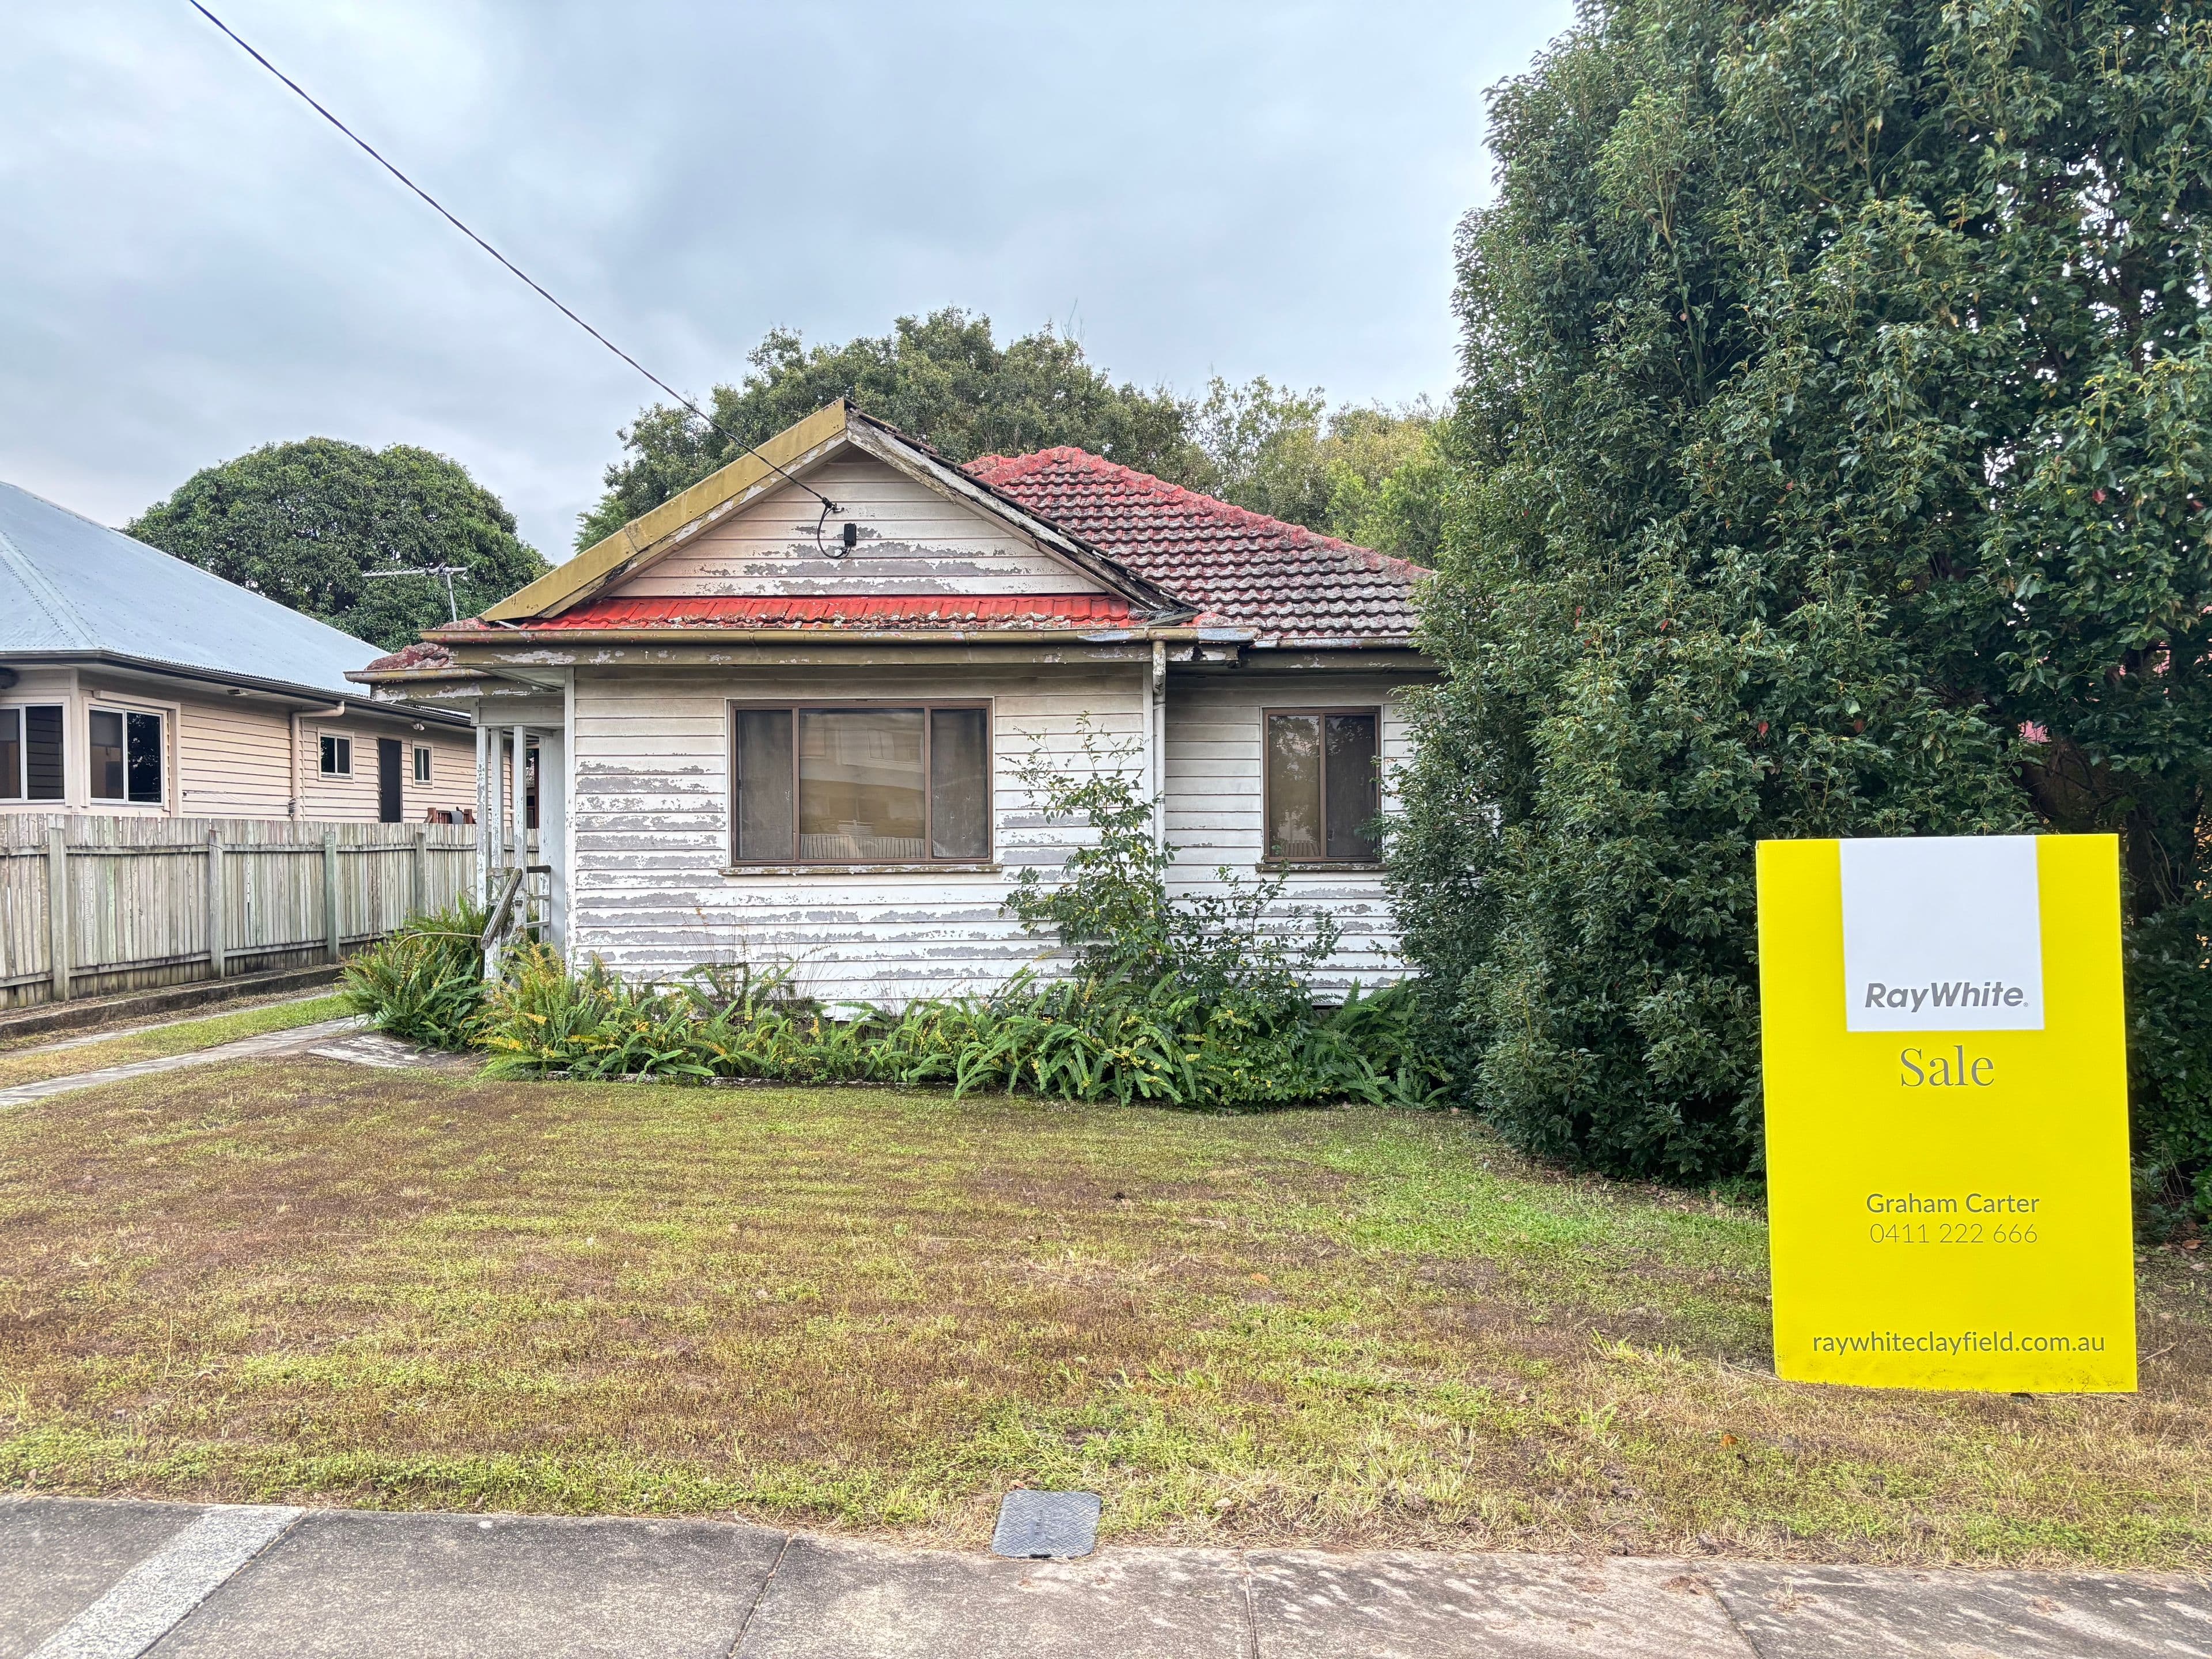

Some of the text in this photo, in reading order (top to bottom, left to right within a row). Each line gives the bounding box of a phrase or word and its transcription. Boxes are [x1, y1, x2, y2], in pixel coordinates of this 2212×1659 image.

[1900, 1045, 1995, 1087] Sale
[1866, 1193, 2040, 1213] Graham Carter
[1870, 1223, 2037, 1243] 0411 222 666
[1813, 1331, 2105, 1356] raywhiteclayfield.com.au
